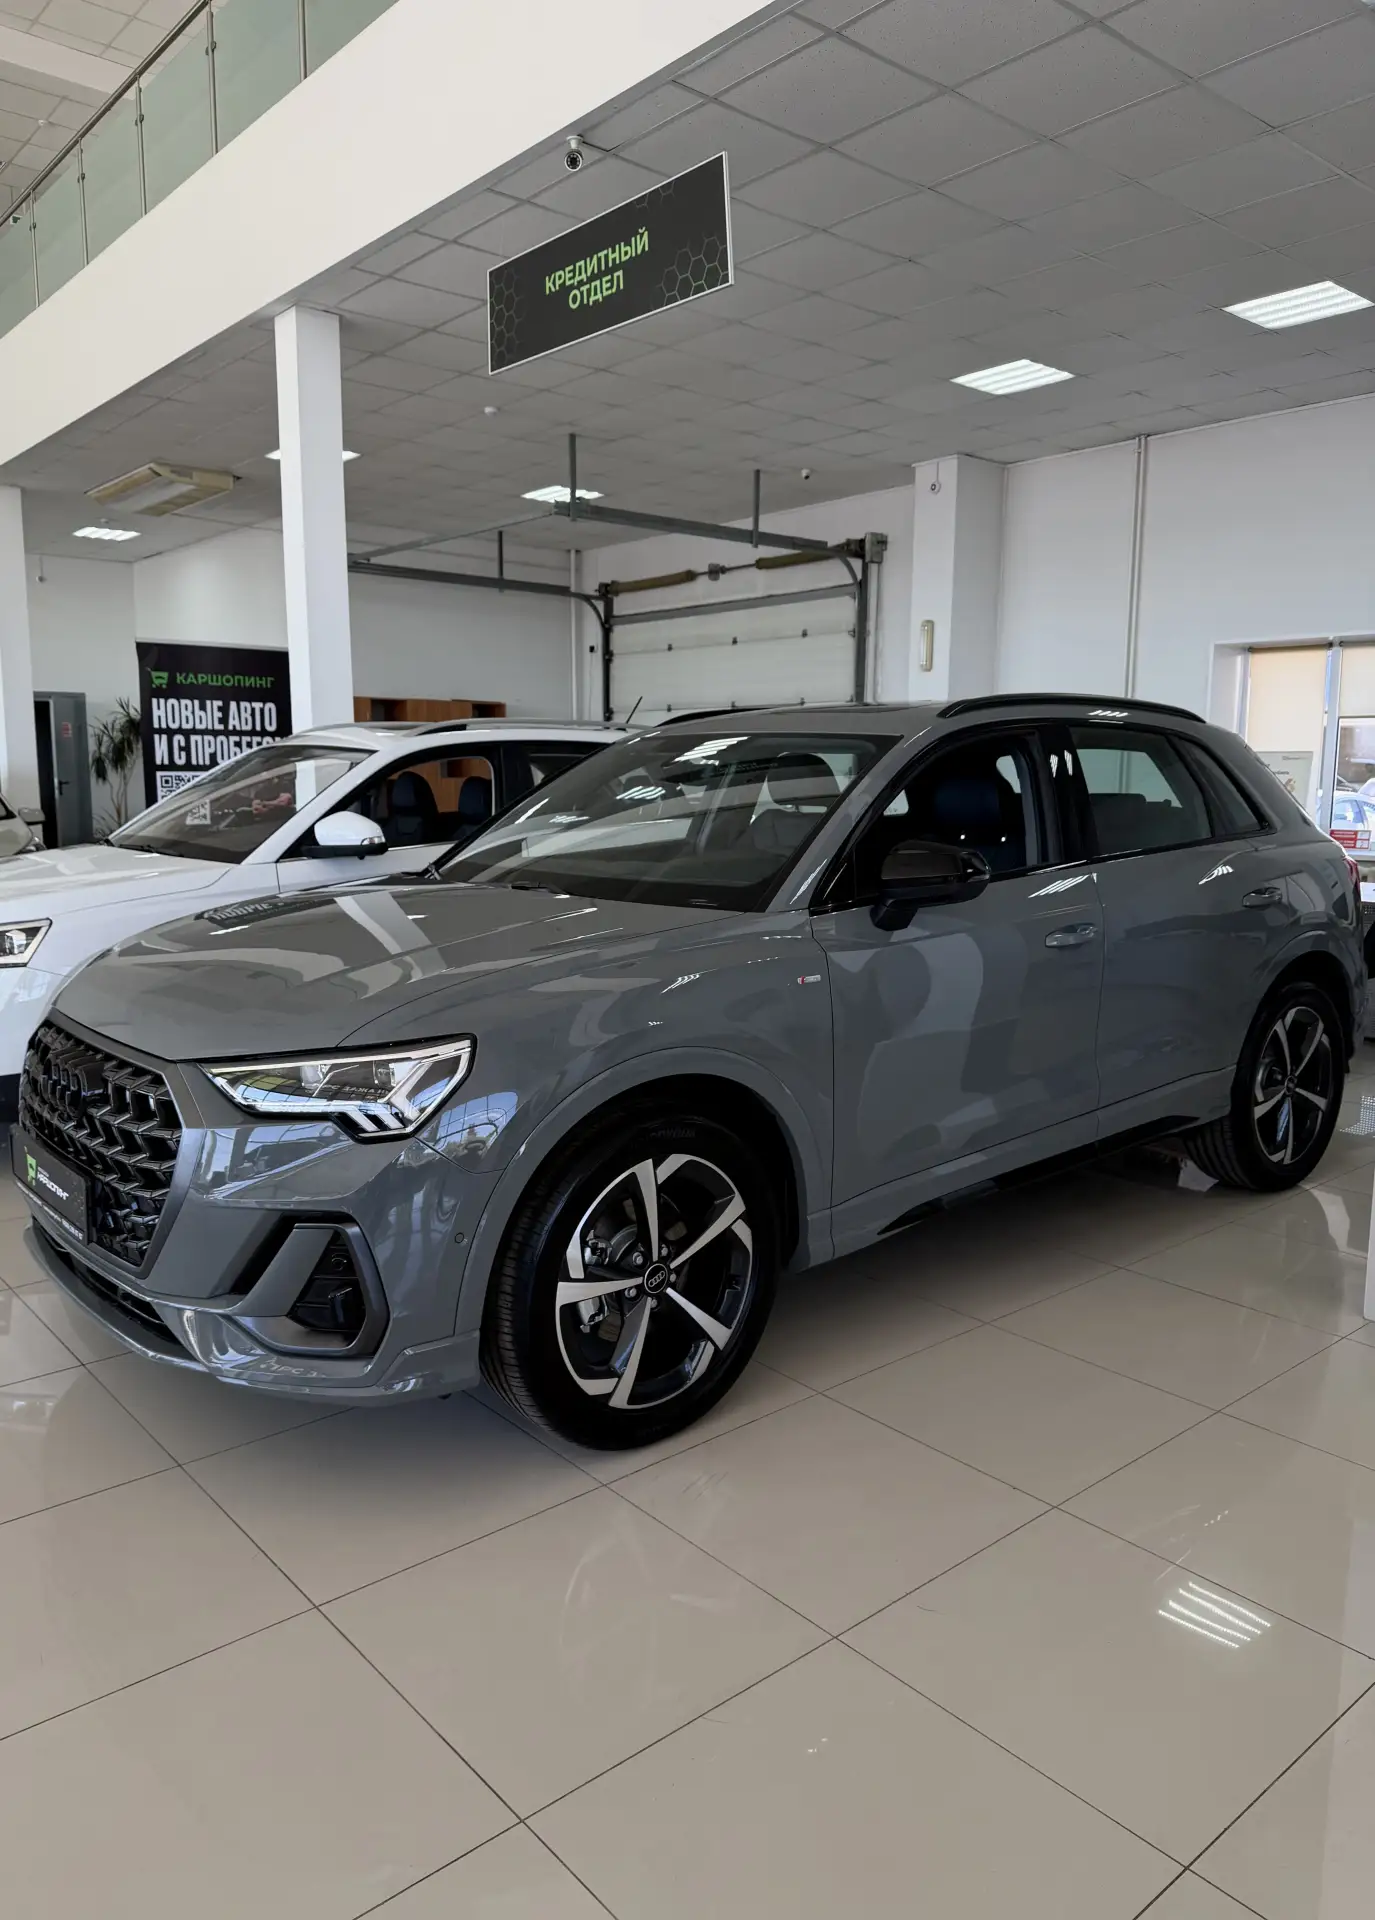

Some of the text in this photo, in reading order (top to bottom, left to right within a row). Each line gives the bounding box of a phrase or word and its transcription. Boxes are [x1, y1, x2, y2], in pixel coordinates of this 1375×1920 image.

[545, 227, 649, 295] КРЕДИТНЫЙ
[568, 270, 624, 310] ОТДЕЛ
[176, 672, 276, 688] КАРШОПИНГ
[152, 698, 278, 732] НОВЫЕ АВТО
[153, 734, 169, 765] И
[172, 734, 186, 765] С
